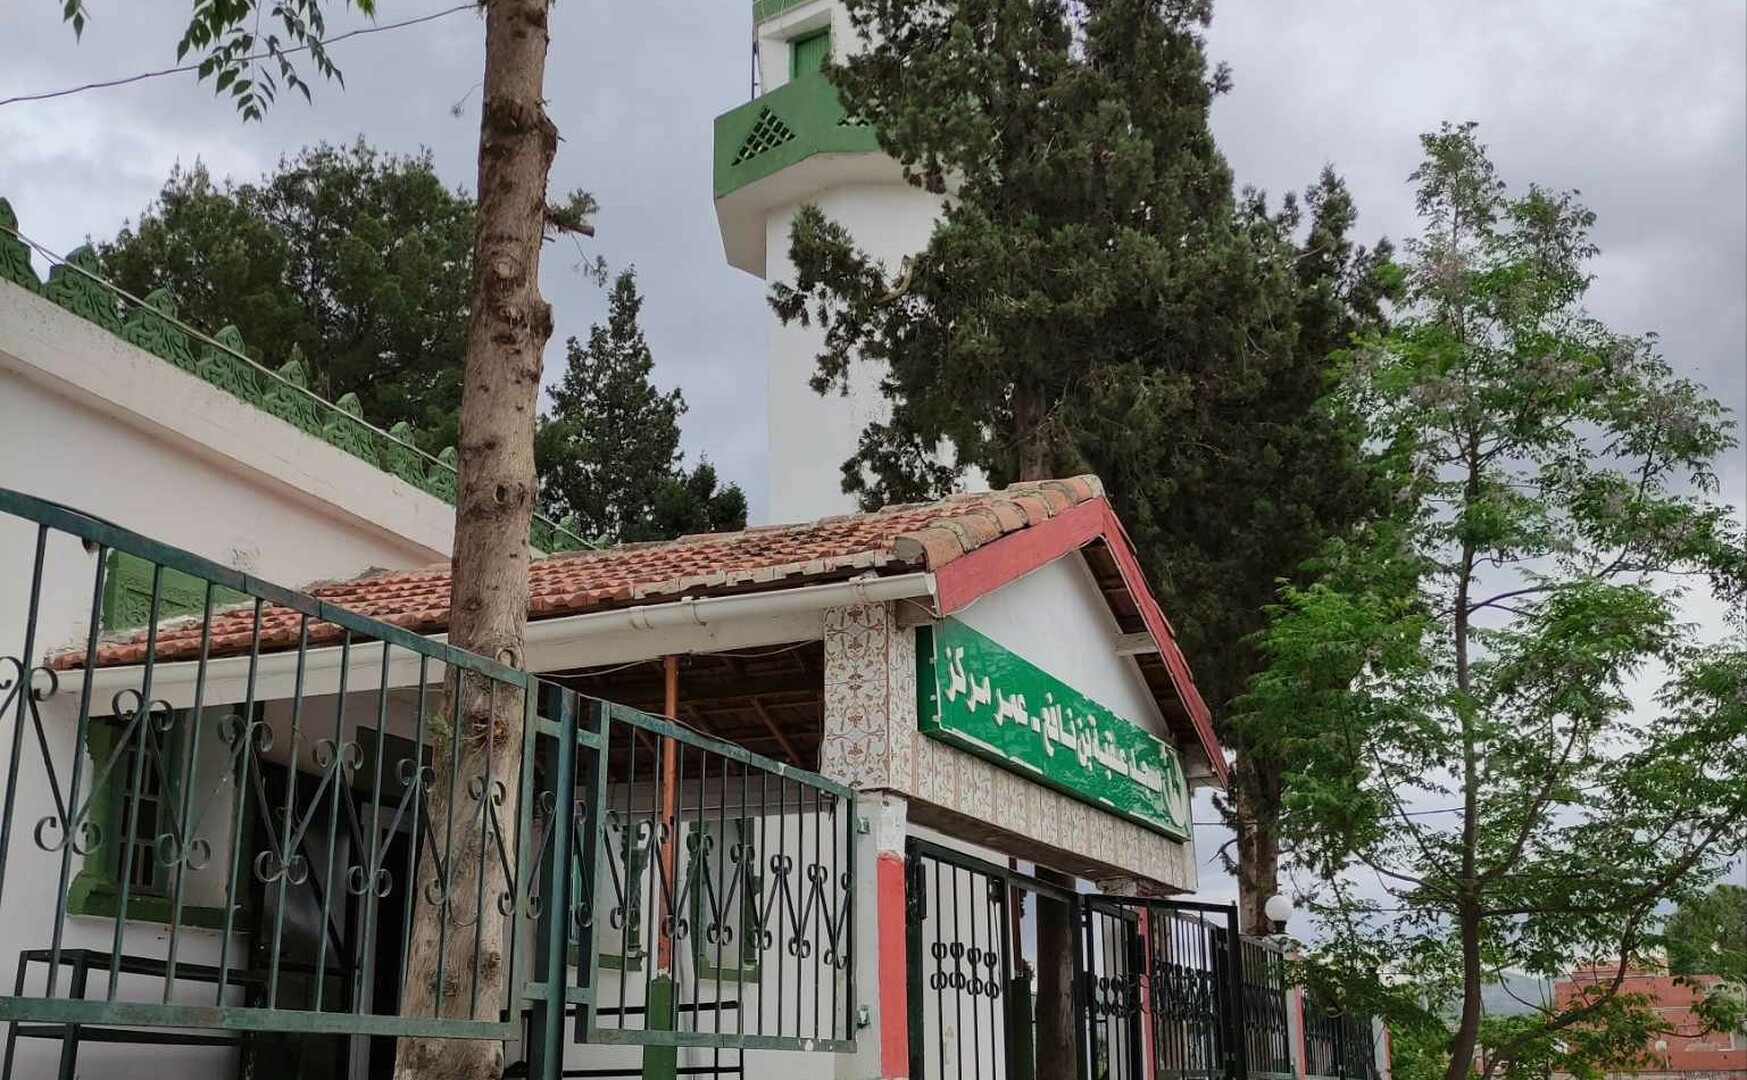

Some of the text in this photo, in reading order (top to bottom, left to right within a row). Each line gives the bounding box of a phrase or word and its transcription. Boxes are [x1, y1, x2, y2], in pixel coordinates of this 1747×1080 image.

[944, 646, 991, 713] مركز
[992, 688, 1028, 726] عمر
[1041, 692, 1076, 757] نافع
[1077, 717, 1093, 771] بن
